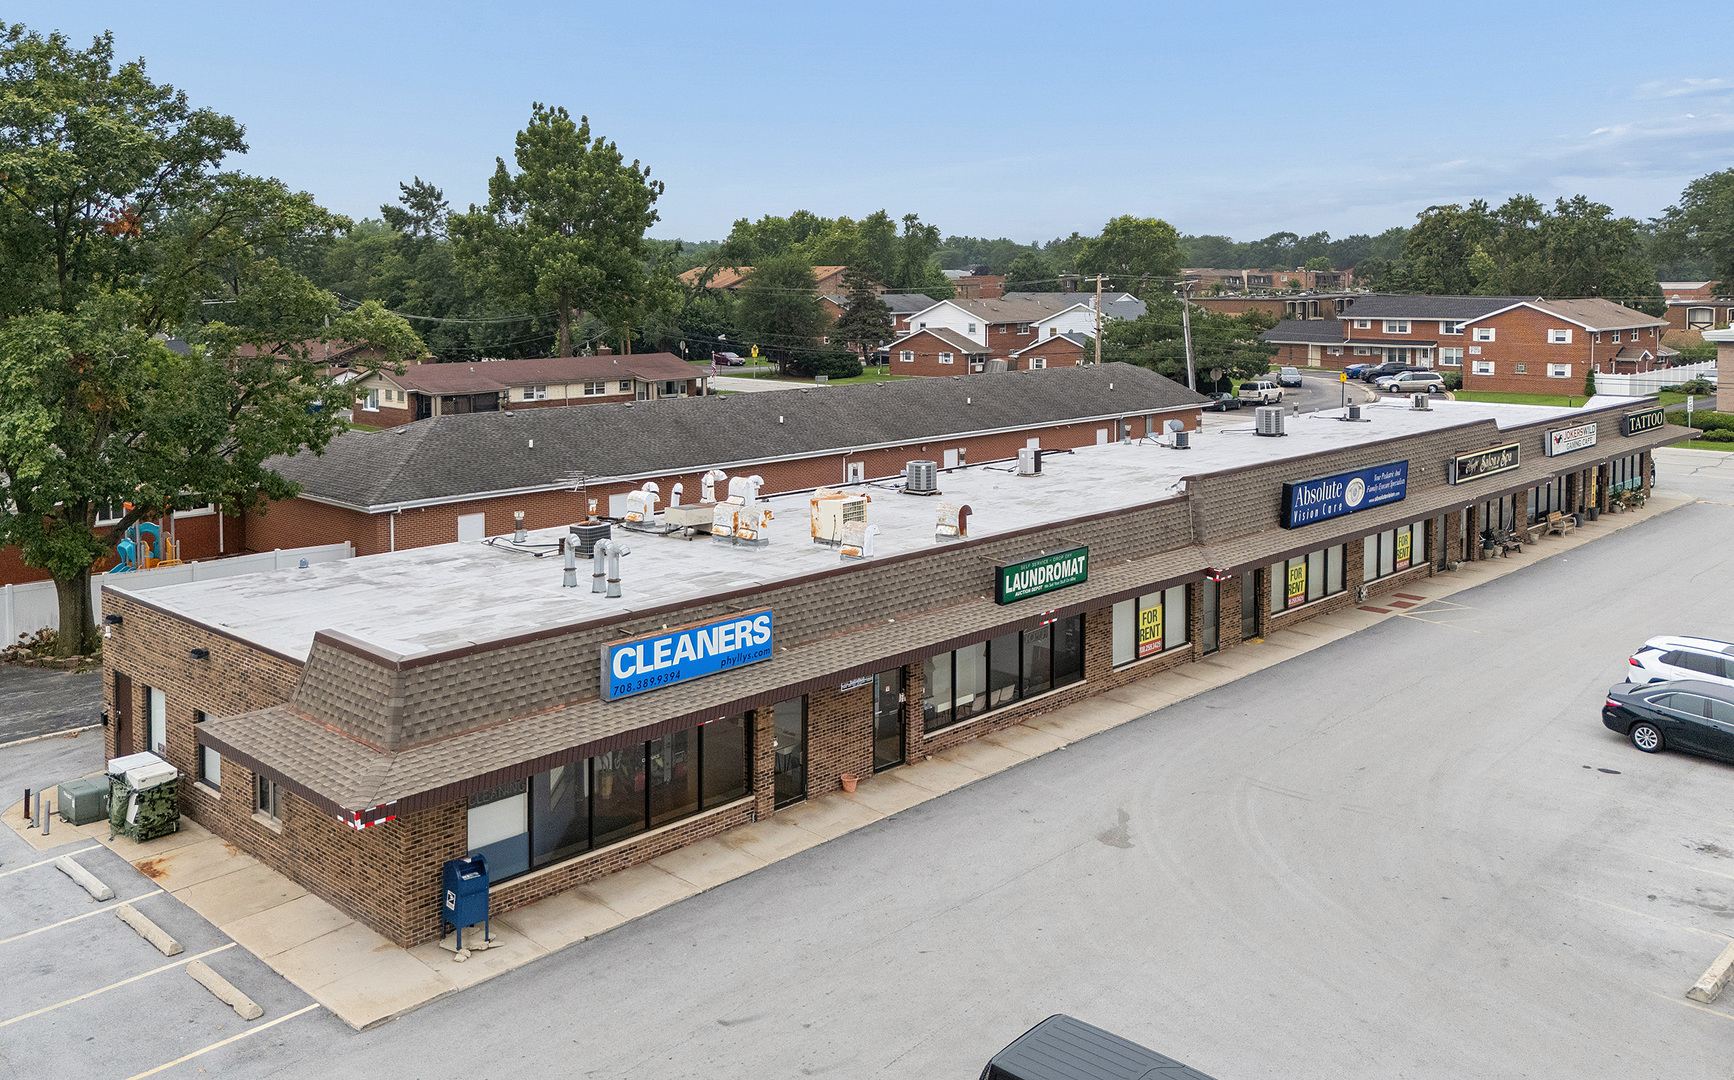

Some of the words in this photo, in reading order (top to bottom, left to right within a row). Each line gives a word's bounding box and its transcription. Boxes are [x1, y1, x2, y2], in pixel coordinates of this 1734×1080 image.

[1630, 411, 1663, 430] TATTOO
[1566, 440, 1581, 450] GAMING
[1582, 436, 1593, 446] CAFE
[1500, 449, 1513, 467] Spa
[1295, 481, 1343, 508] Absolute
[1293, 508, 1319, 523] Vision
[1322, 502, 1343, 515] Care
[1398, 534, 1409, 548] FOR
[1006, 556, 1085, 593] LAUNDROMAT
[1290, 567, 1303, 582] FOR
[1015, 588, 1031, 597] AUCTION
[1031, 584, 1043, 593] DEPOT
[1142, 609, 1158, 626] FOR
[1140, 623, 1161, 642] RENT
[613, 615, 771, 679] CLEANERS
[721, 648, 771, 669] phyllys.com
[613, 670, 681, 696] 708.389.9394
